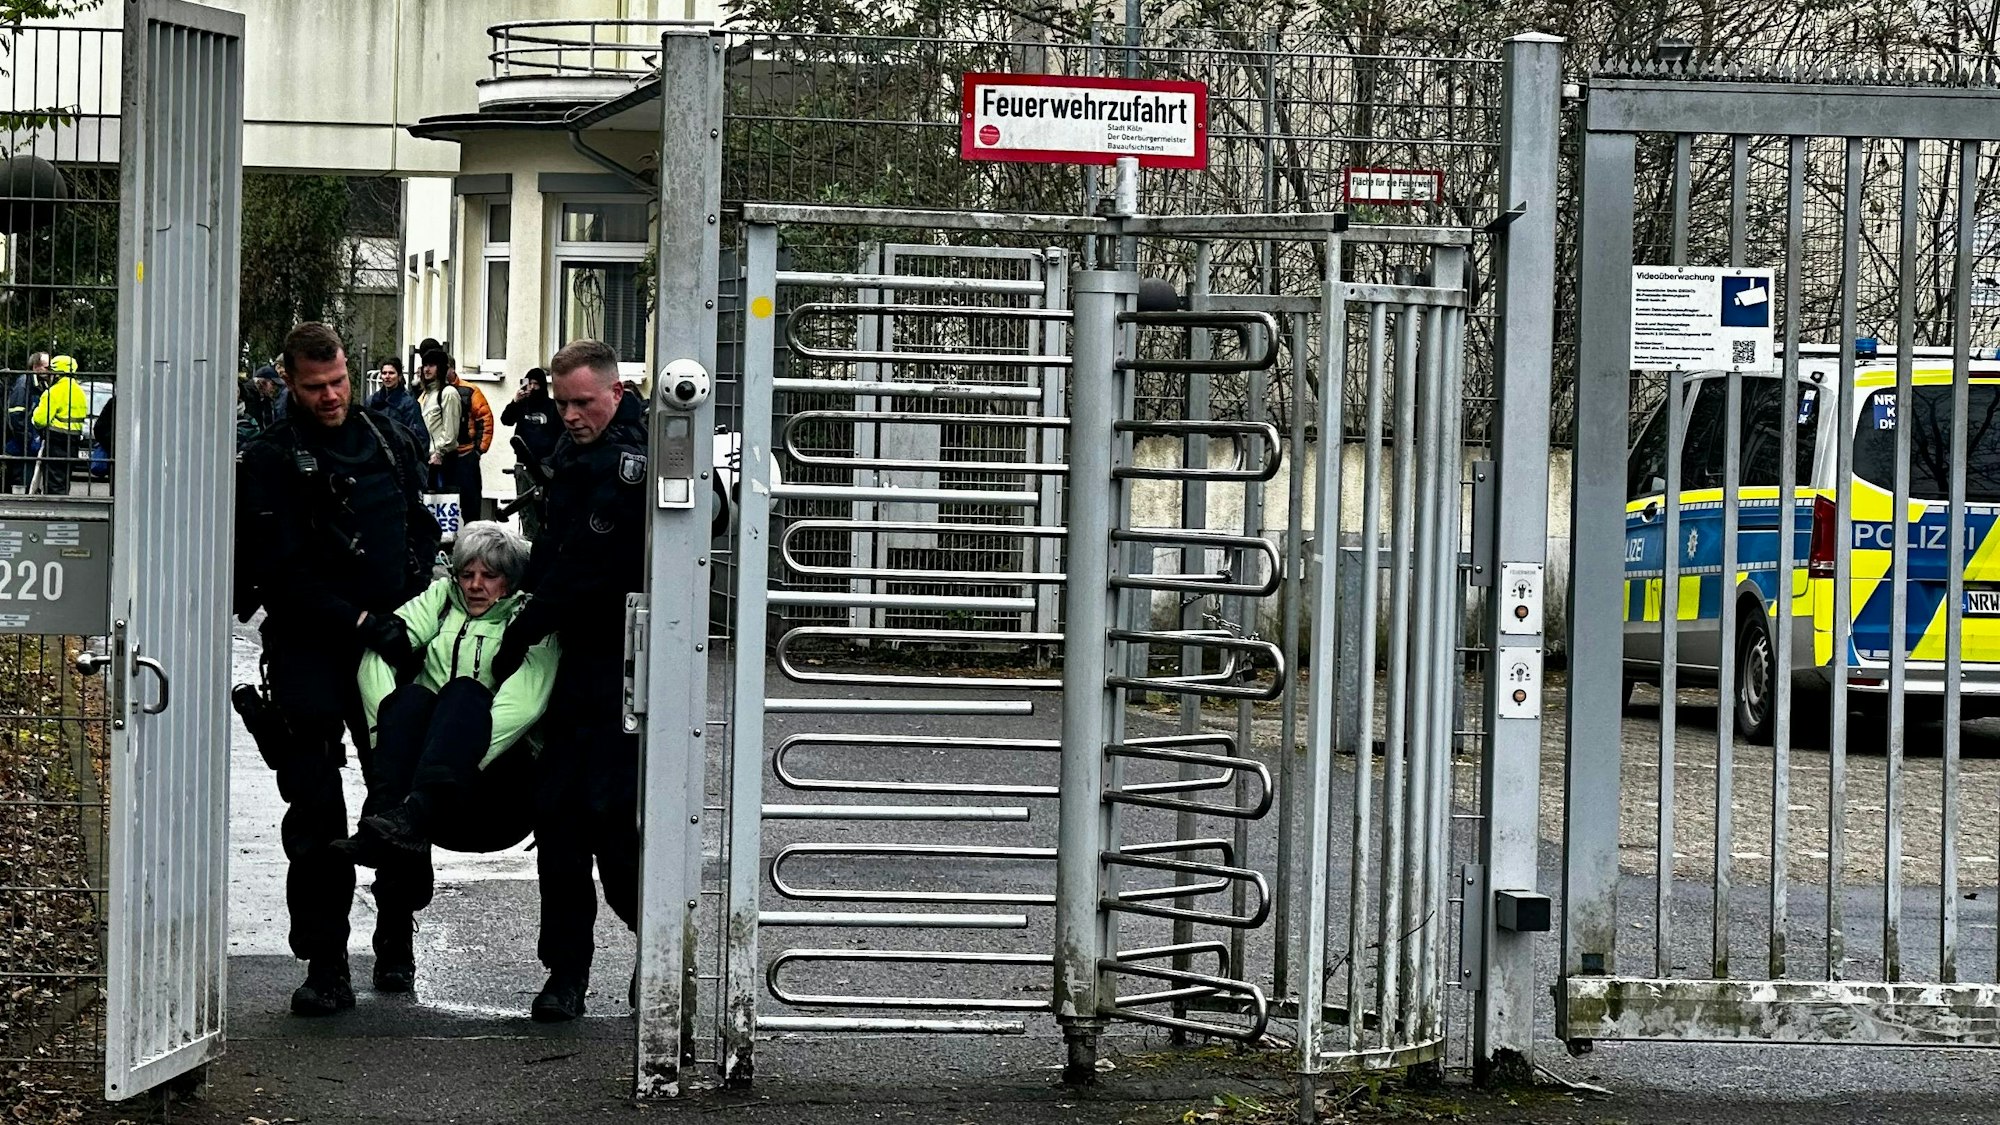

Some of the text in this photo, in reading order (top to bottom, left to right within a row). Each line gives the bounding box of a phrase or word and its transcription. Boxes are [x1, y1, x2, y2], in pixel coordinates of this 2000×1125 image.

[982, 88, 1187, 125] Feuerwehrzufahrt
[1107, 124, 1143, 133] Stadt Köln
[1107, 133, 1120, 141] Der
[1375, 177, 1386, 187] für
[1386, 178, 1397, 187] de
[1636, 271, 1715, 282] Videoüberwachung
[1873, 394, 1897, 406] NR
[1854, 523, 1975, 551] POIZI
[0, 559, 63, 601] 220
[1968, 592, 2000, 611] NRW
